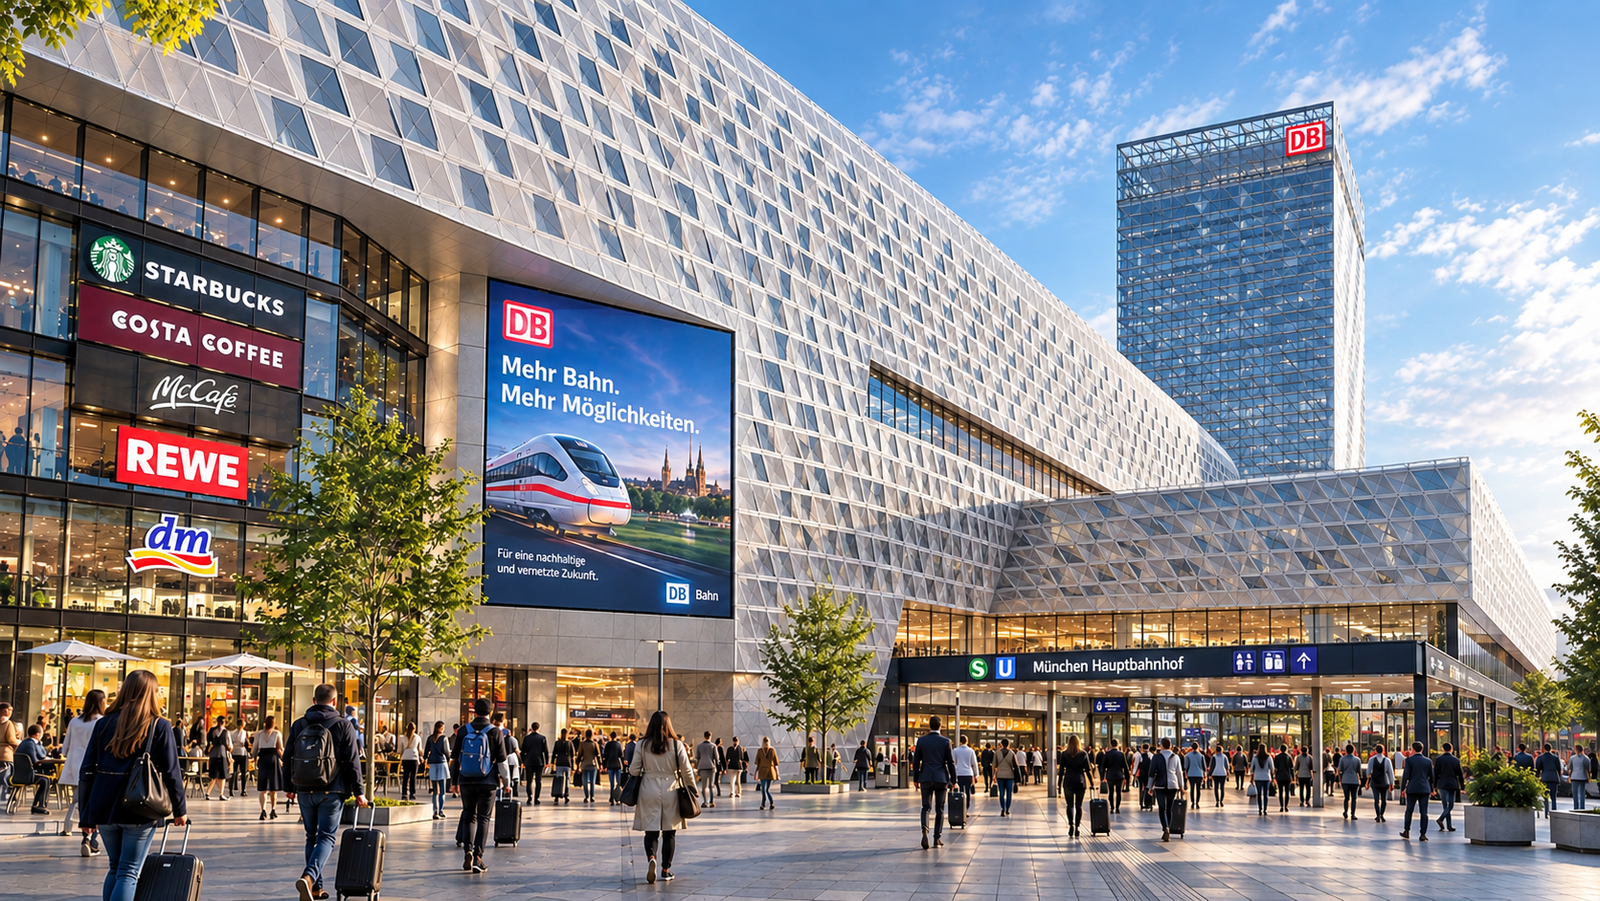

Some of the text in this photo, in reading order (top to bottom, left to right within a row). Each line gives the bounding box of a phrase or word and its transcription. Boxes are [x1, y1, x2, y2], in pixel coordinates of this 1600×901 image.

[1291, 127, 1321, 151] DB
[145, 260, 285, 317] STARBUCKS
[111, 309, 283, 369] COSTA COFFEE
[509, 307, 548, 340] DB
[151, 374, 239, 415] McCafé
[502, 355, 620, 395] Mehr Bahn.
[501, 383, 700, 435] Mehr Möglichkeiten.
[127, 437, 240, 489] REWE
[148, 515, 209, 554] dm
[497, 547, 586, 568] Für eine nachhaltige
[497, 564, 515, 574] und
[561, 568, 599, 581] Zukunft.
[669, 586, 719, 601] DB Bahn
[972, 655, 1185, 678] S U München Hauptbahnhof
